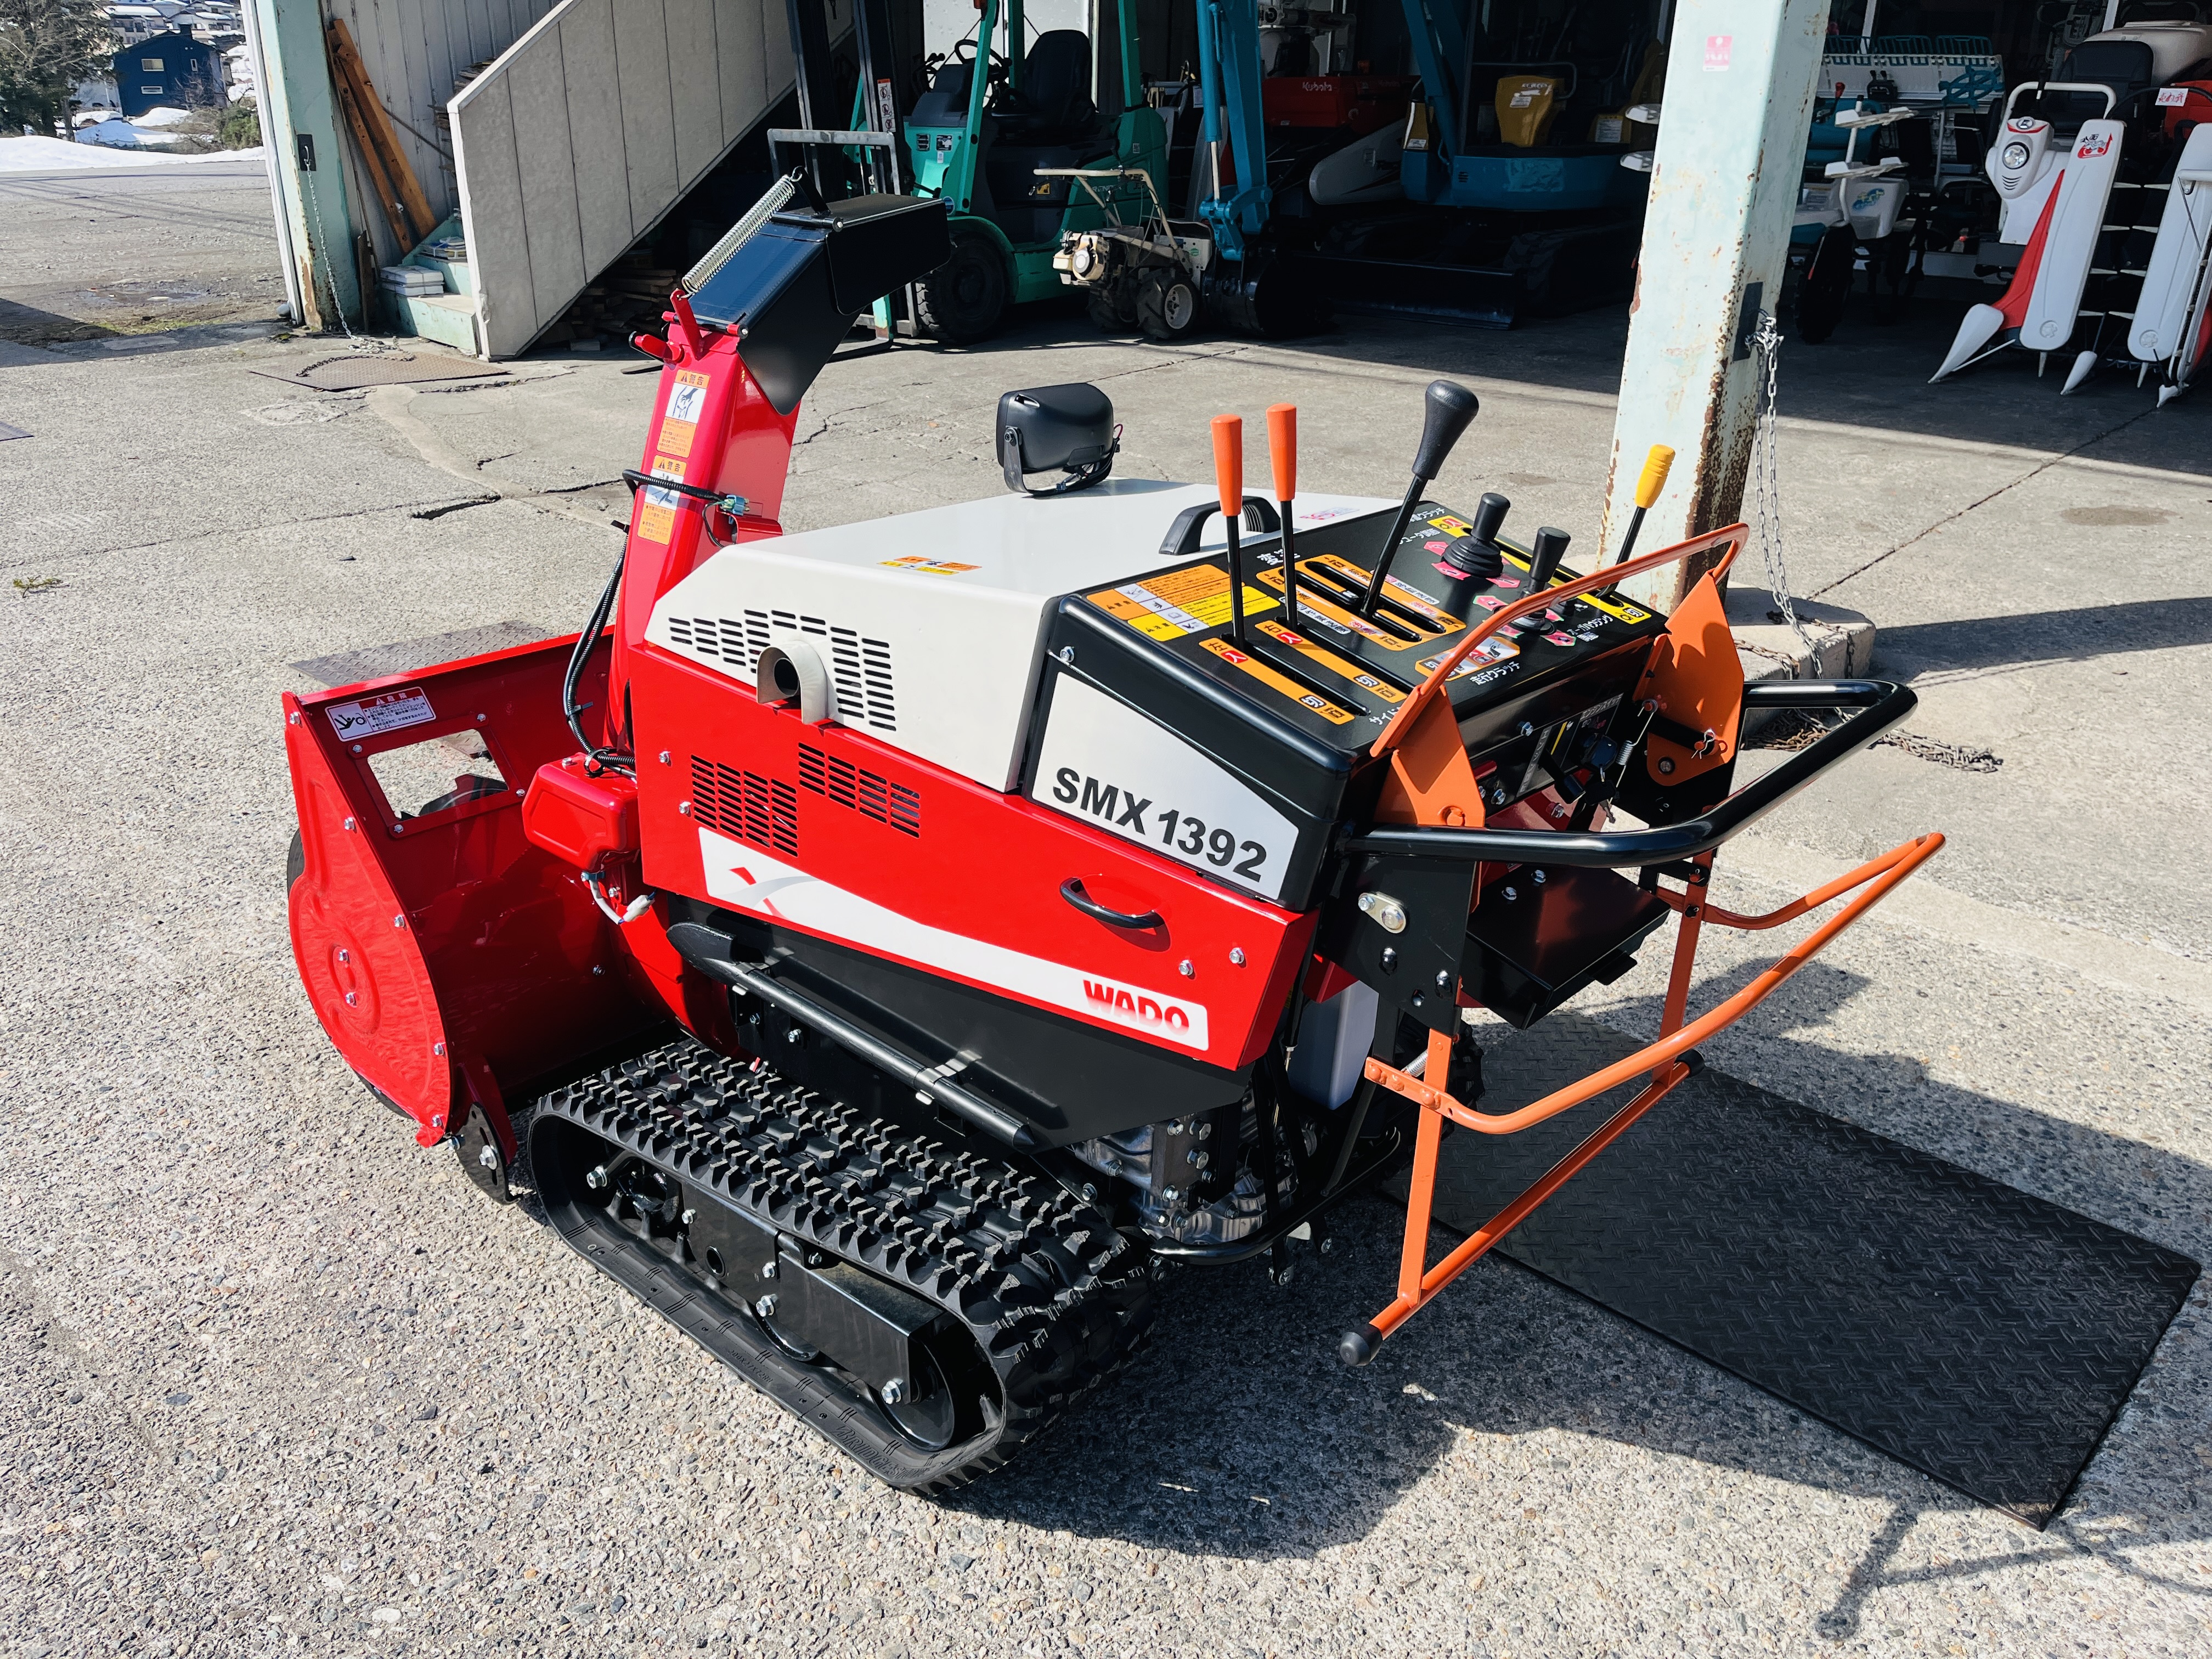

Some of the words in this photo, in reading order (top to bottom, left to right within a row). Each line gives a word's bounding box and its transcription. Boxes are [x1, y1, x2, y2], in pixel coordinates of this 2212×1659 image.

[1302, 81, 1333, 92] Kubota
[689, 374, 704, 386] 警告
[667, 461, 681, 472] 警告
[1263, 624, 1282, 633] 右
[1283, 633, 1303, 644] 入
[1207, 642, 1228, 652] 左
[1227, 651, 1247, 664] 入
[1469, 661, 1520, 685] 走行クラッチ
[1356, 675, 1378, 687] 切
[1300, 696, 1325, 708] 切
[1369, 706, 1401, 725] サイド
[1052, 767, 1153, 836] SMX
[1158, 809, 1267, 883] 1392
[1082, 979, 1190, 1036] WADO
